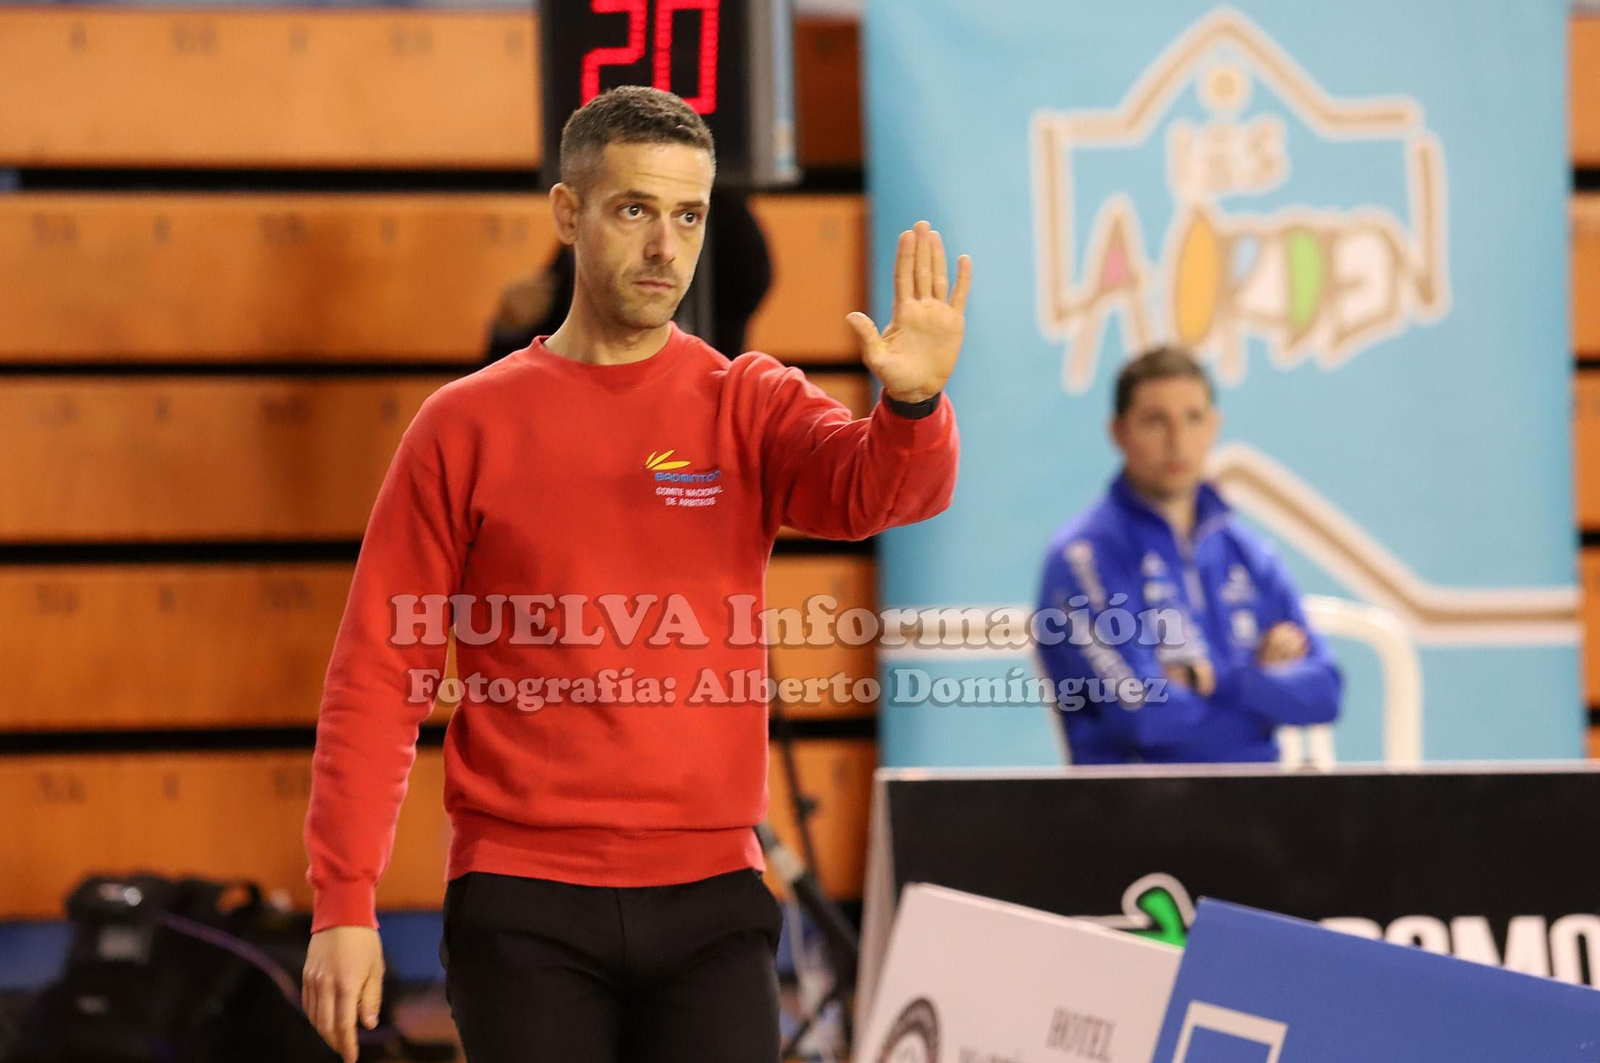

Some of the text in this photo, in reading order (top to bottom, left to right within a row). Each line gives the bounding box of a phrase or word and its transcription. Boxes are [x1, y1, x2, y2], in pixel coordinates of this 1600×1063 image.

[580, 0, 720, 115] 20
[685, 485, 723, 497] NACIONAL
[665, 497, 677, 506] DE
